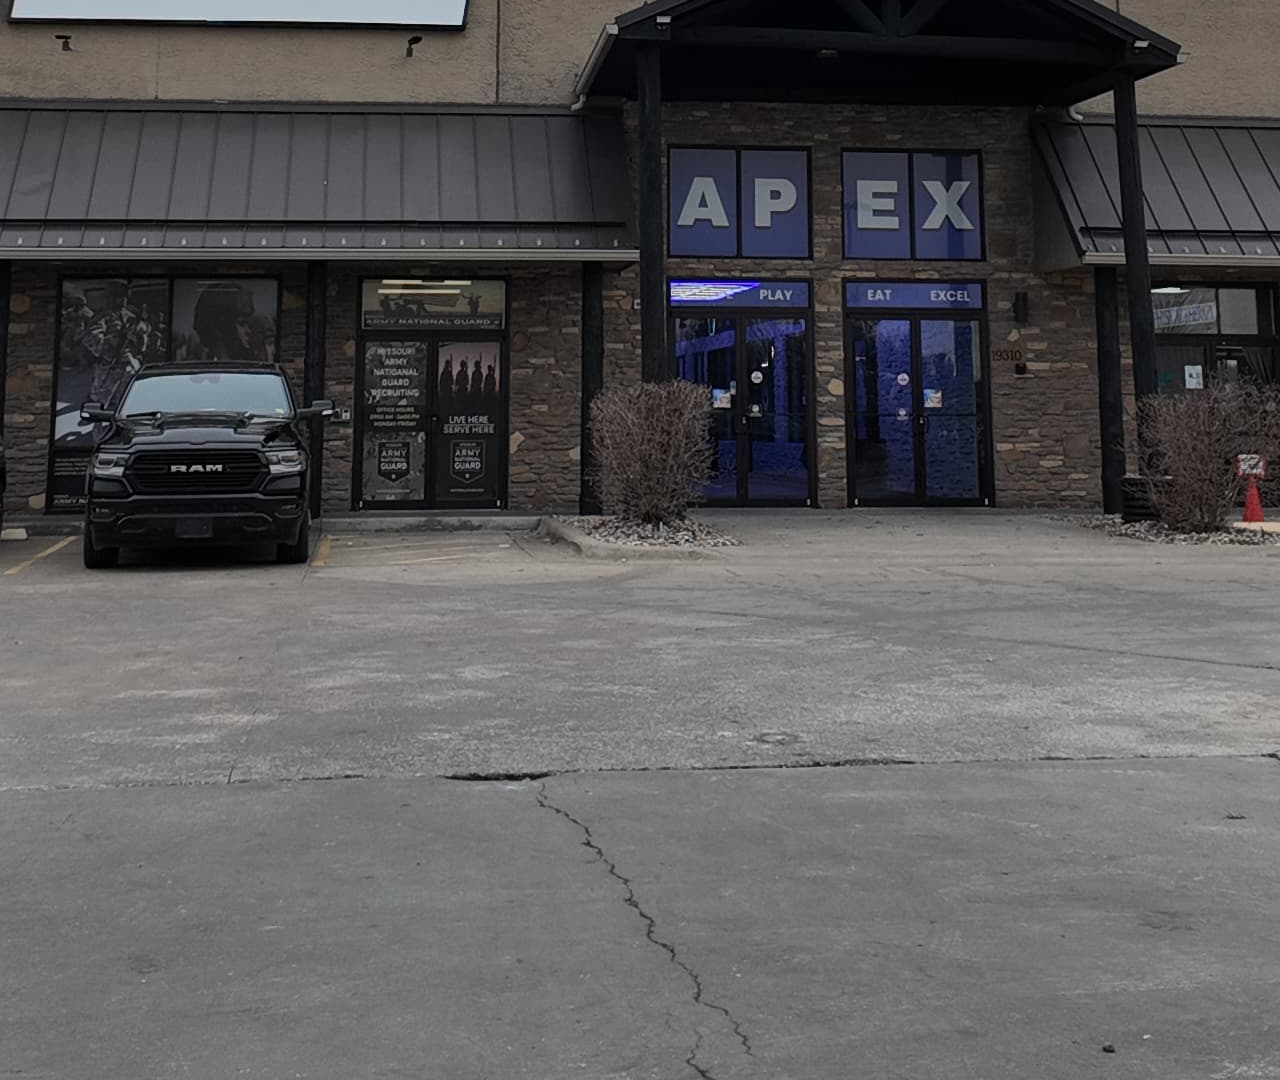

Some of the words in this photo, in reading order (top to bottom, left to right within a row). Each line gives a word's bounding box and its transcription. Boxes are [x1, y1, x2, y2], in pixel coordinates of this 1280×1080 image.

[759, 289, 793, 301] PLAY
[867, 289, 892, 301] EAT
[930, 290, 970, 302] EXCEL
[992, 350, 1022, 361] 19310
[384, 358, 408, 366] ARMY
[381, 378, 410, 386] GUARD
[449, 416, 466, 424] LIVE
[468, 416, 489, 424] HERE
[443, 425, 470, 434] SERVE
[472, 425, 494, 434] HERE
[381, 449, 407, 457] ARMY
[170, 464, 223, 473] RAM
[380, 462, 407, 470] GUARD
